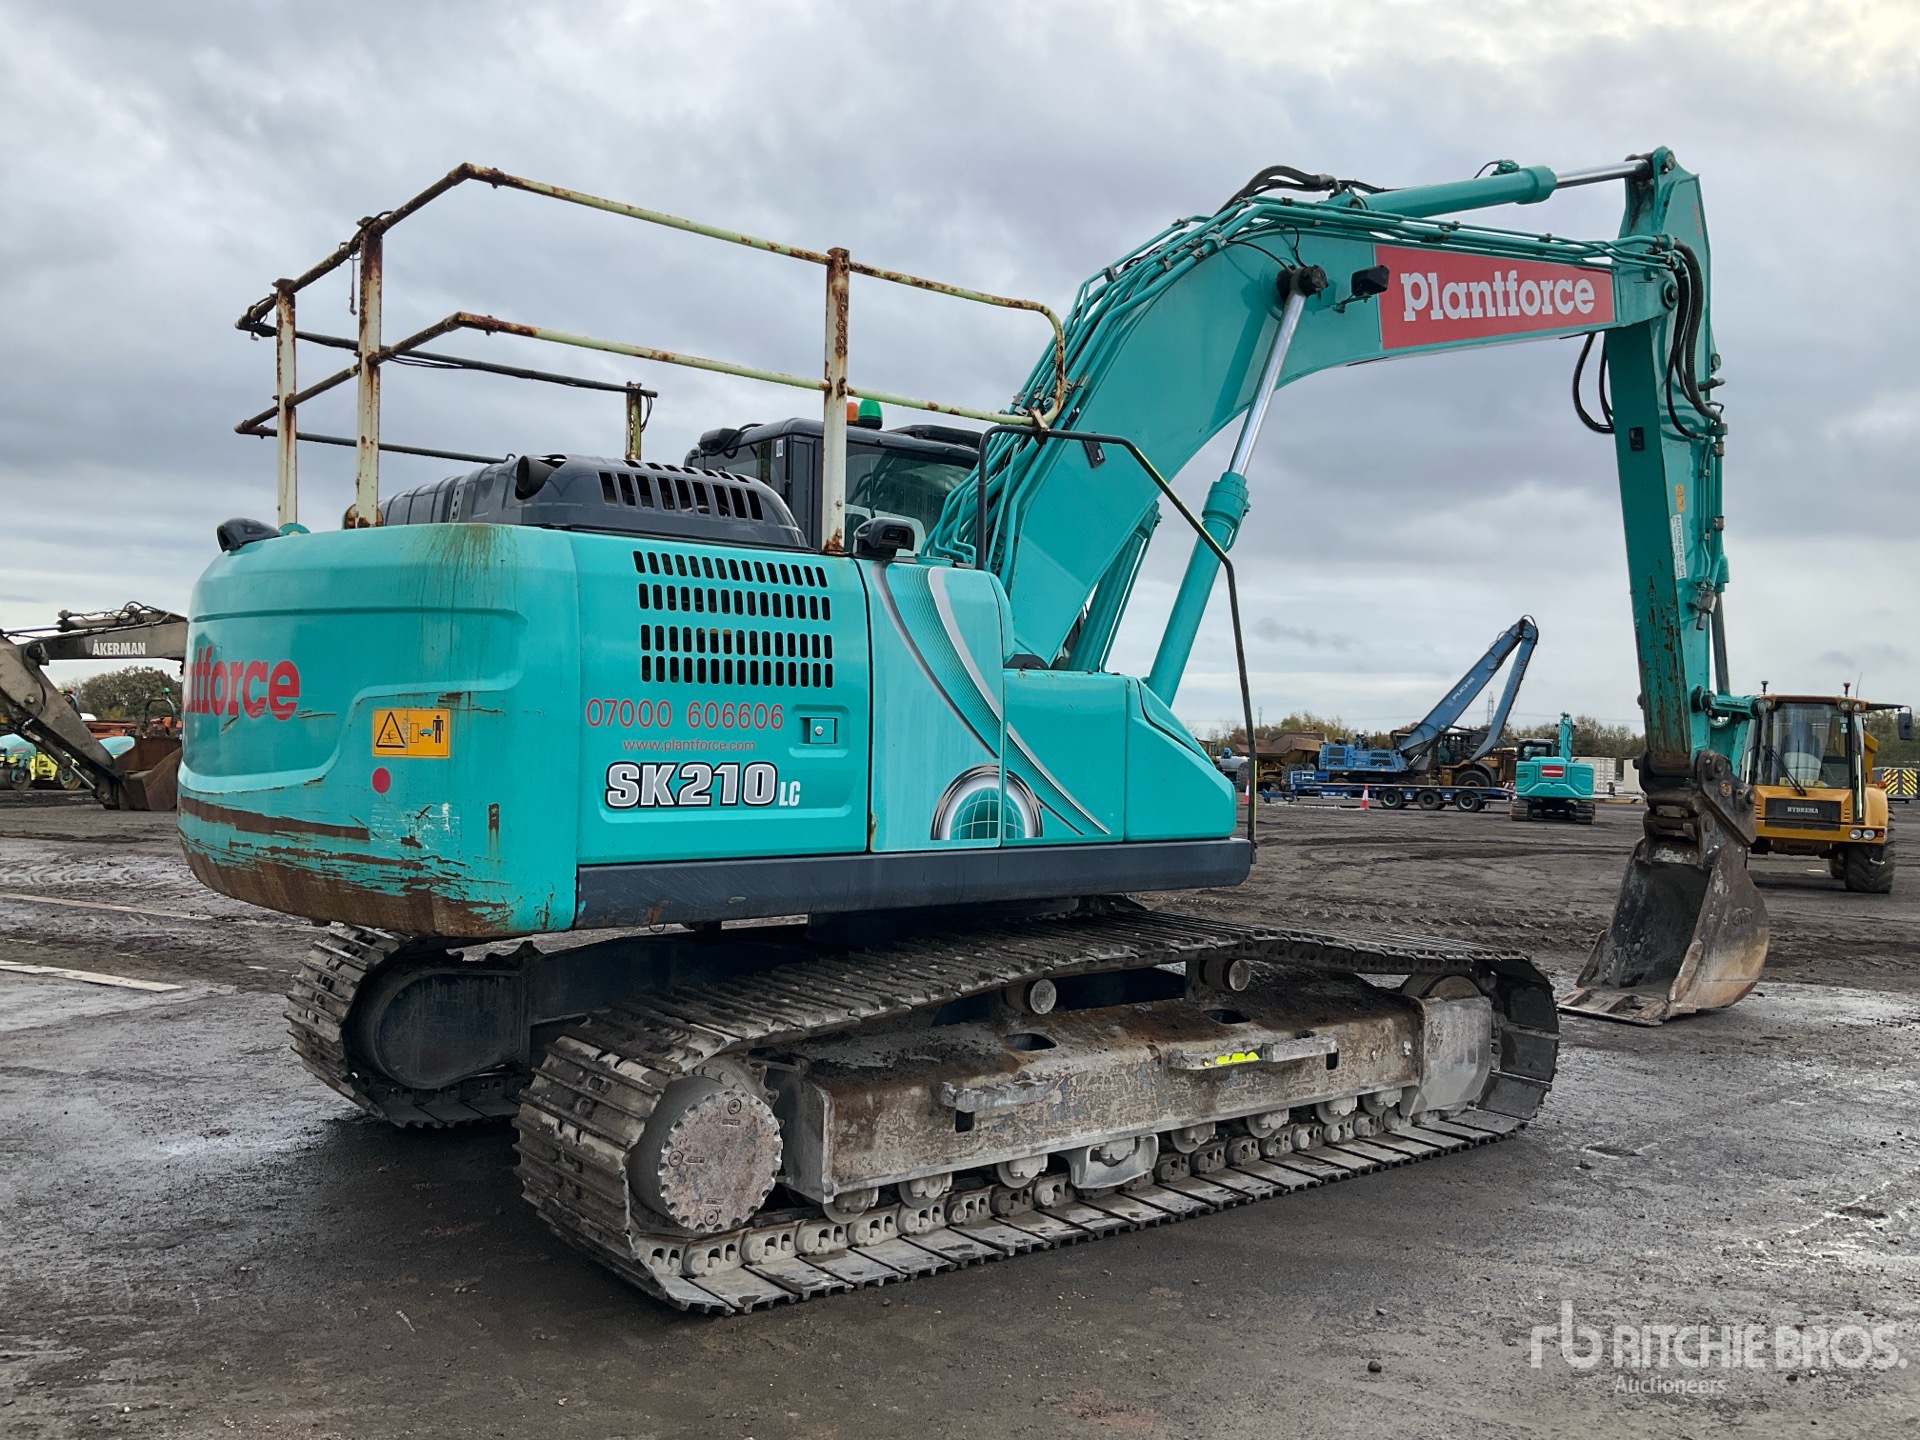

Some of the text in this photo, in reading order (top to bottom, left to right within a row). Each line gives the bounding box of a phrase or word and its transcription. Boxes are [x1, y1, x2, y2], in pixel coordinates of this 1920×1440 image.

[92, 639, 146, 656] ÅKERMAN
[1452, 676, 1475, 700] FUCHS
[586, 698, 784, 730] 07000 606606
[623, 738, 756, 752] www.plantforce.com
[605, 761, 801, 809] SK210 LC
